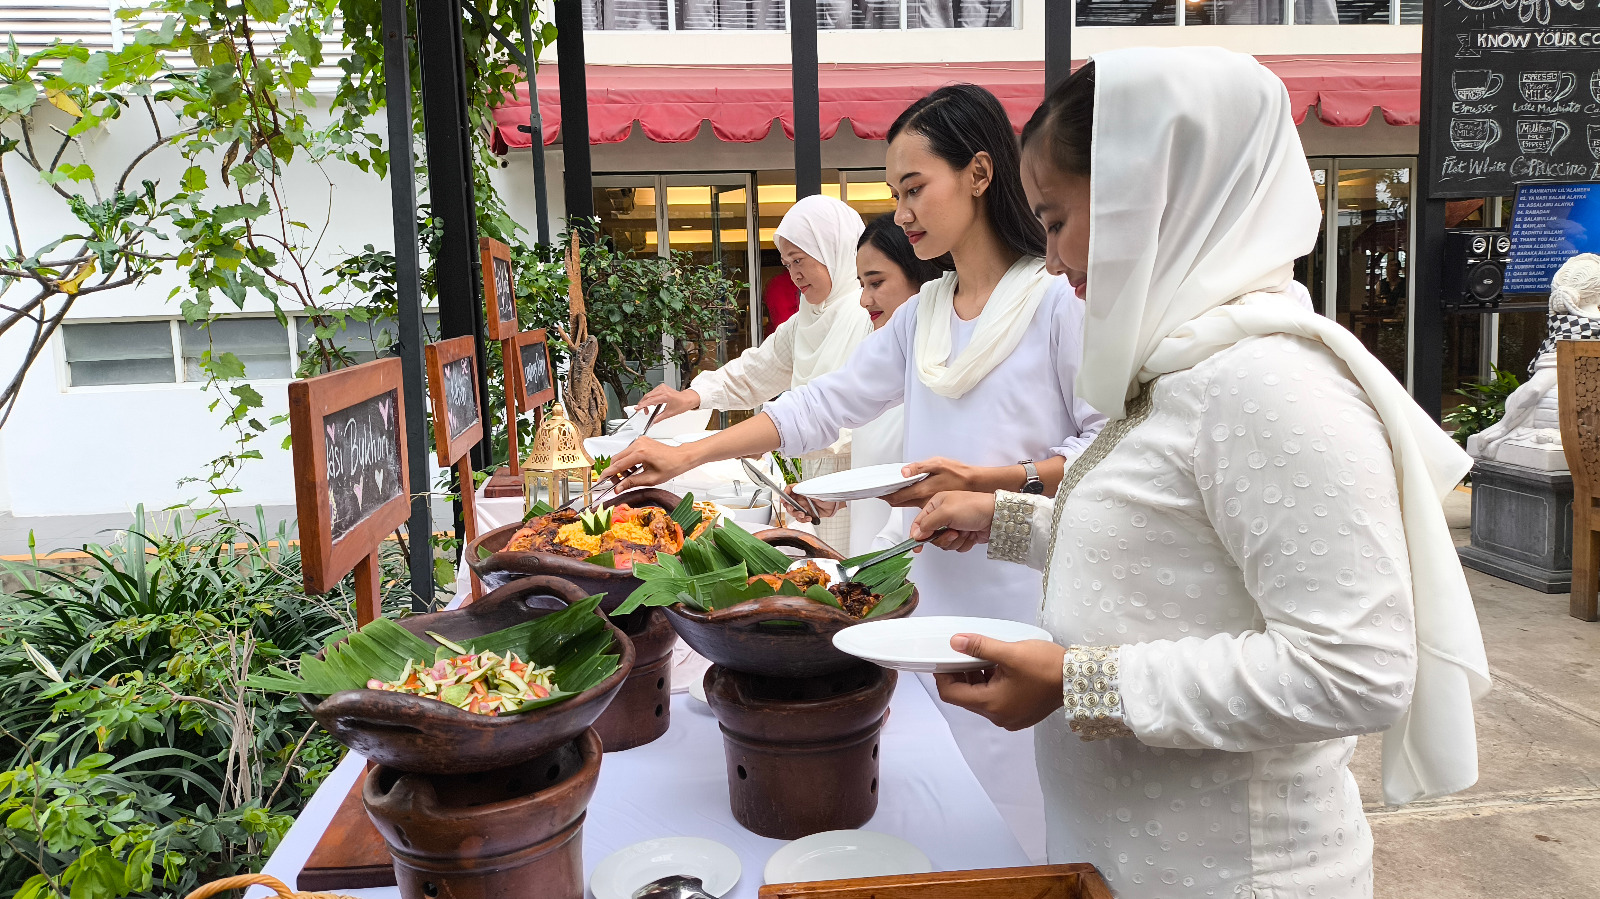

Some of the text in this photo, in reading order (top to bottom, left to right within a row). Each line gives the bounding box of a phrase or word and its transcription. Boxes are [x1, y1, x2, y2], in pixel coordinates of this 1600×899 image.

[1477, 32, 1531, 48] KNOW
[1534, 32, 1577, 47] YOUR
[1525, 90, 1553, 101] MILK
[1469, 156, 1506, 176] White
